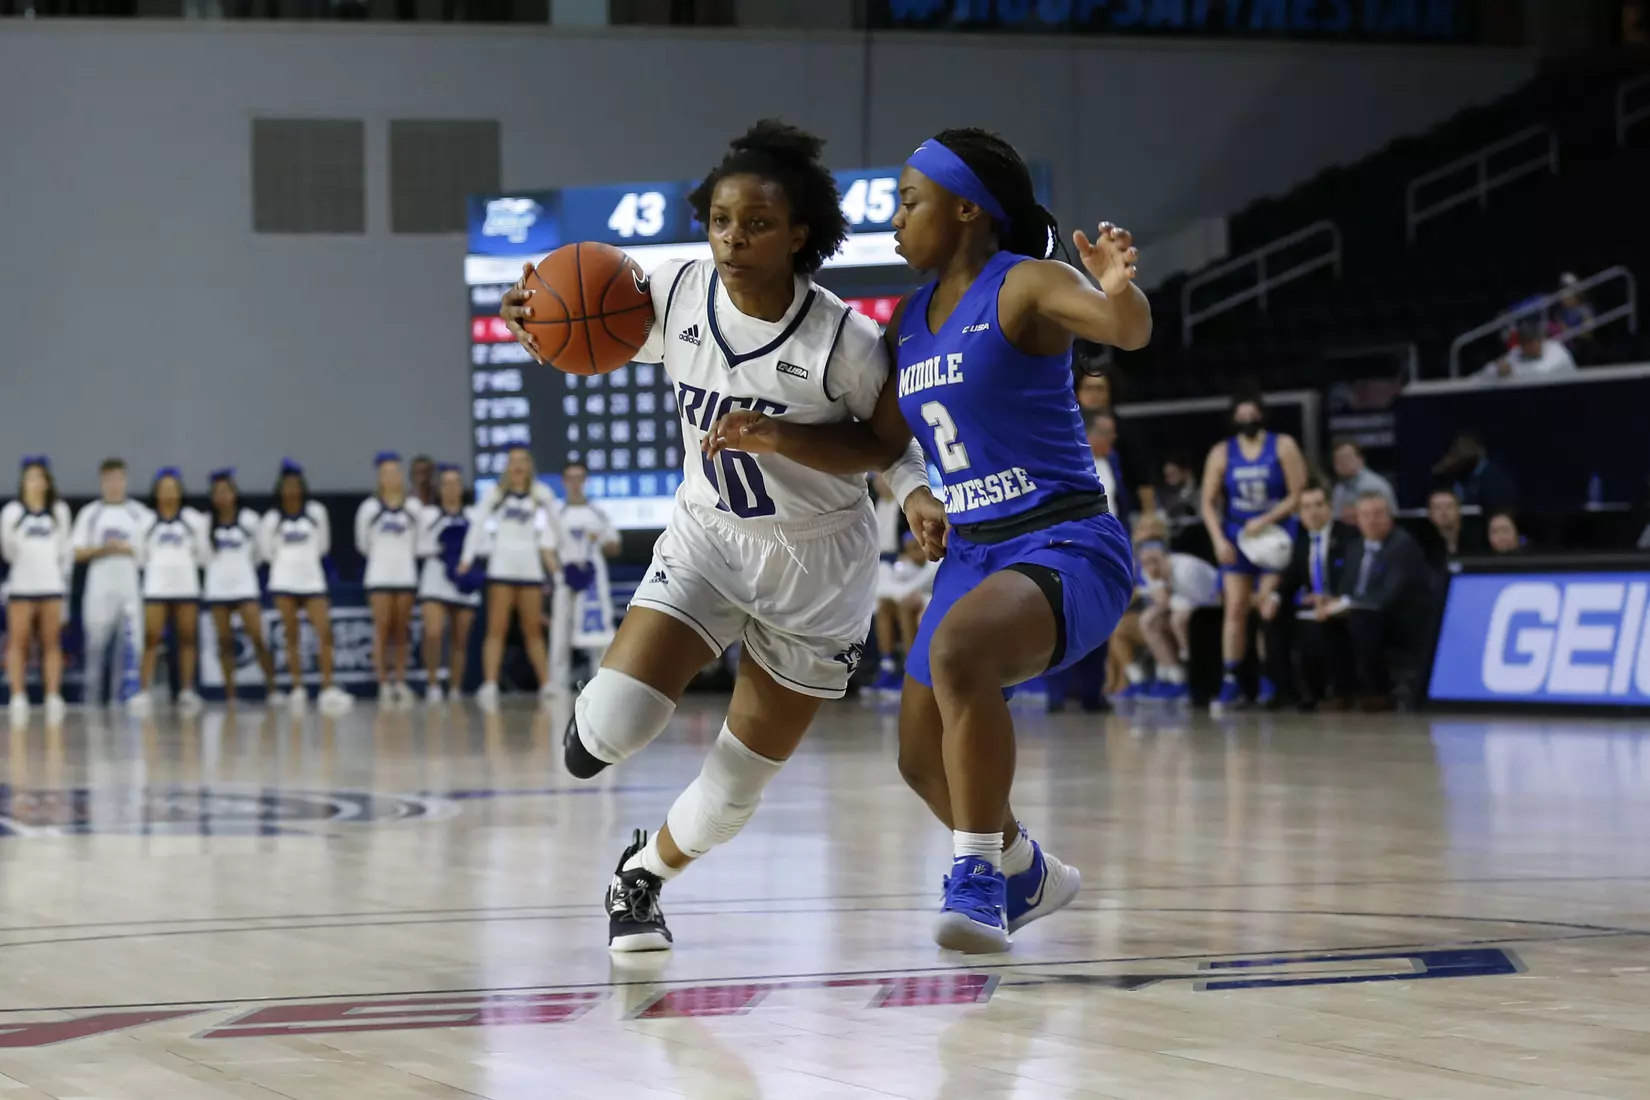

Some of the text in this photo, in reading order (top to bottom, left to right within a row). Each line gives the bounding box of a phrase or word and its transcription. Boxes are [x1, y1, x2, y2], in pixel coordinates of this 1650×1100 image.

[608, 191, 666, 238] 43
[840, 177, 898, 225] 45
[898, 352, 964, 398] MIDDLE
[921, 400, 971, 474] 2
[700, 439, 776, 519] 10
[1482, 581, 1650, 697] GEI
